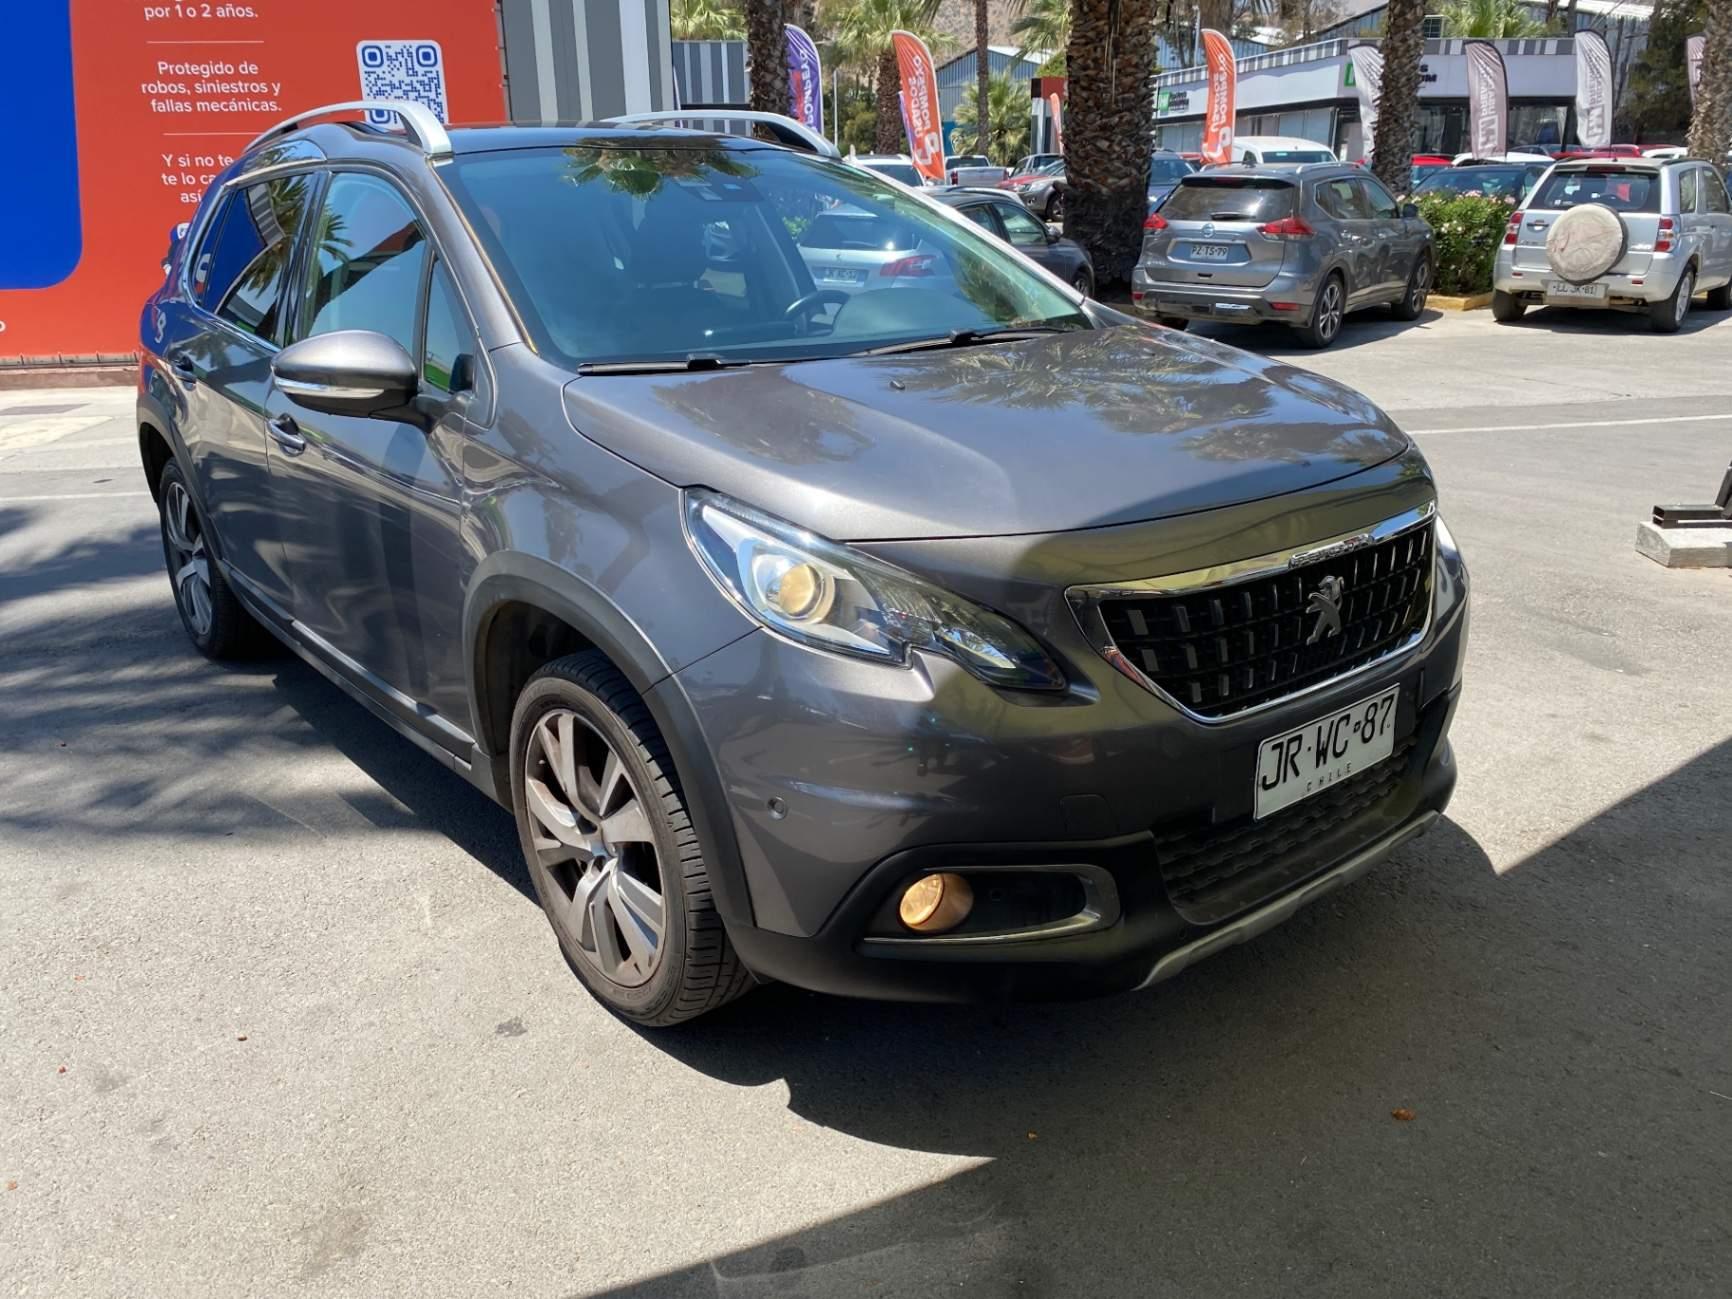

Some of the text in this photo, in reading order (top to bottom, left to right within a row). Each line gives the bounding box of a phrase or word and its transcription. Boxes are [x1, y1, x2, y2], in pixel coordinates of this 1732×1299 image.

[144, 3, 259, 21] por 1 o 2 años.
[157, 61, 259, 78] Protegido de
[141, 80, 281, 96] robos, siniestros y
[150, 98, 282, 112] fallas mecánicas.
[162, 154, 234, 167] Y si no te
[161, 174, 177, 185] te
[182, 172, 196, 185] lo
[1306, 762, 1352, 793] CHILE
